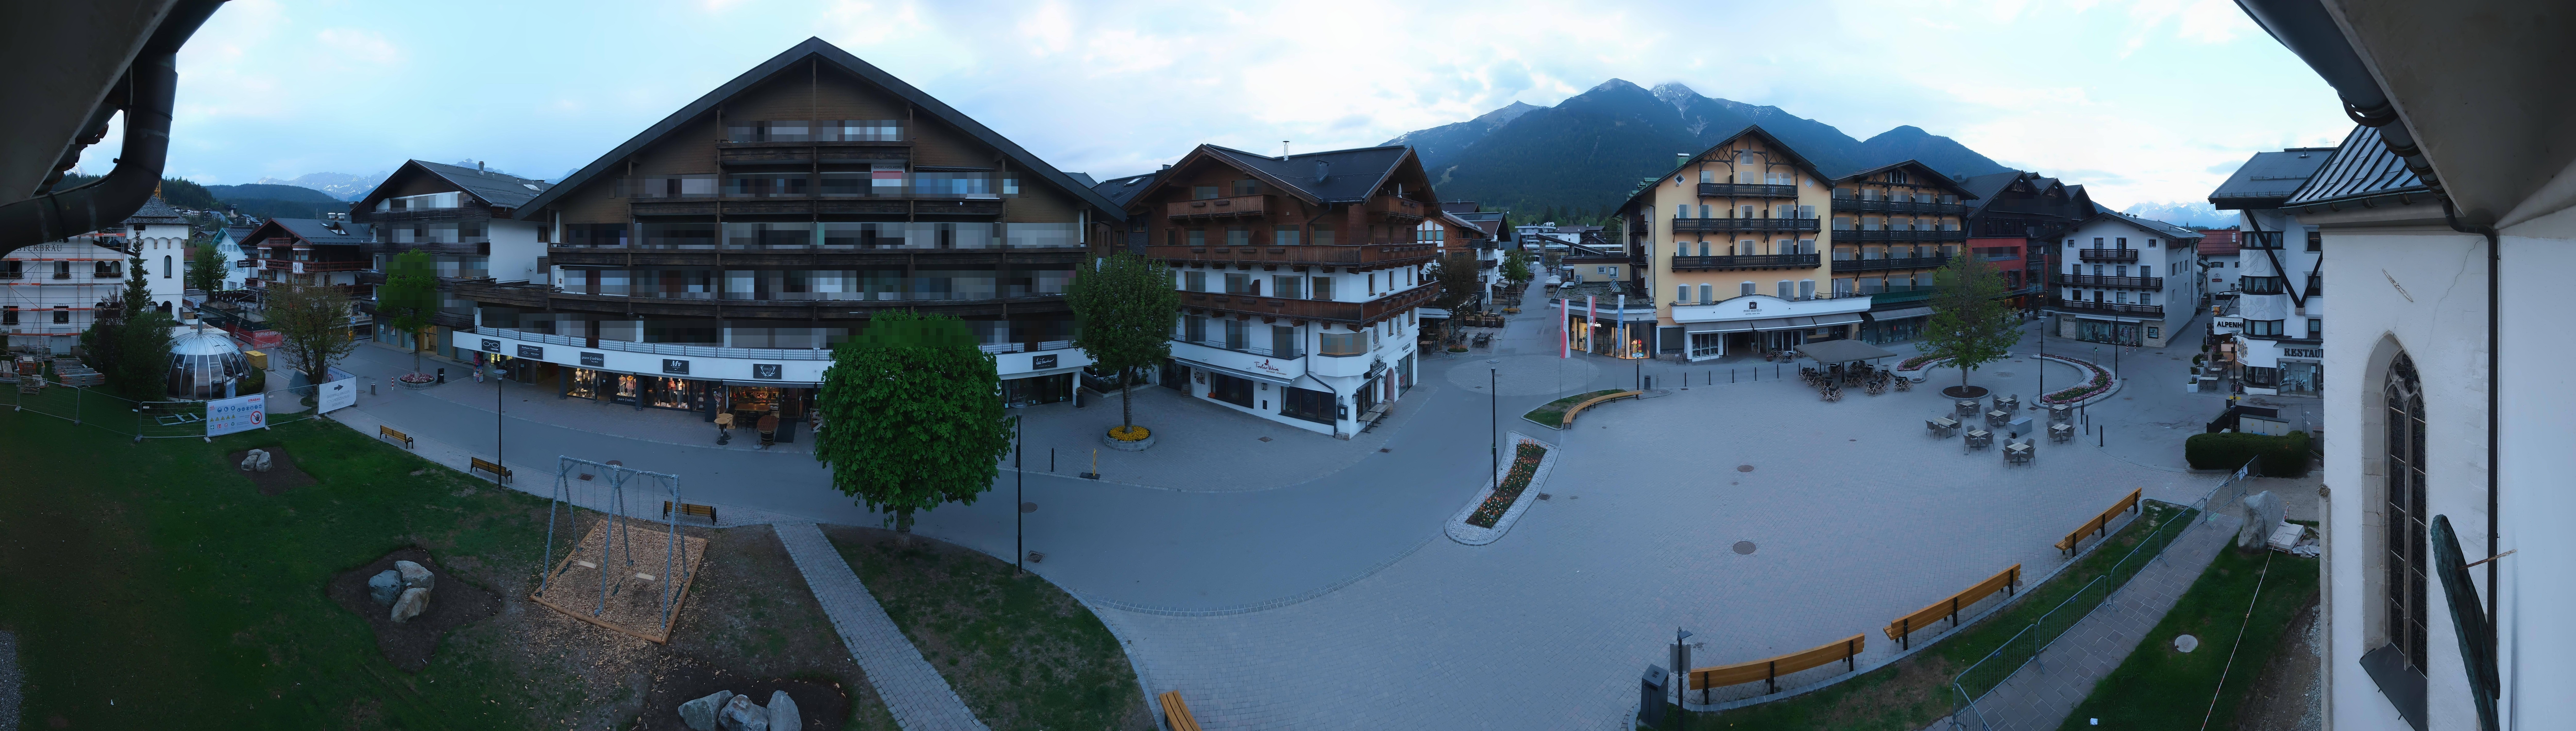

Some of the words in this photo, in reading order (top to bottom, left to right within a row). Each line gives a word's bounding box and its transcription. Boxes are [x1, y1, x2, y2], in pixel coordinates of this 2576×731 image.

[1402, 343, 1411, 352] SAILER
[1372, 364, 1385, 377] RESTAURANT
[327, 395, 350, 403] KONGRESSZENTRUM
